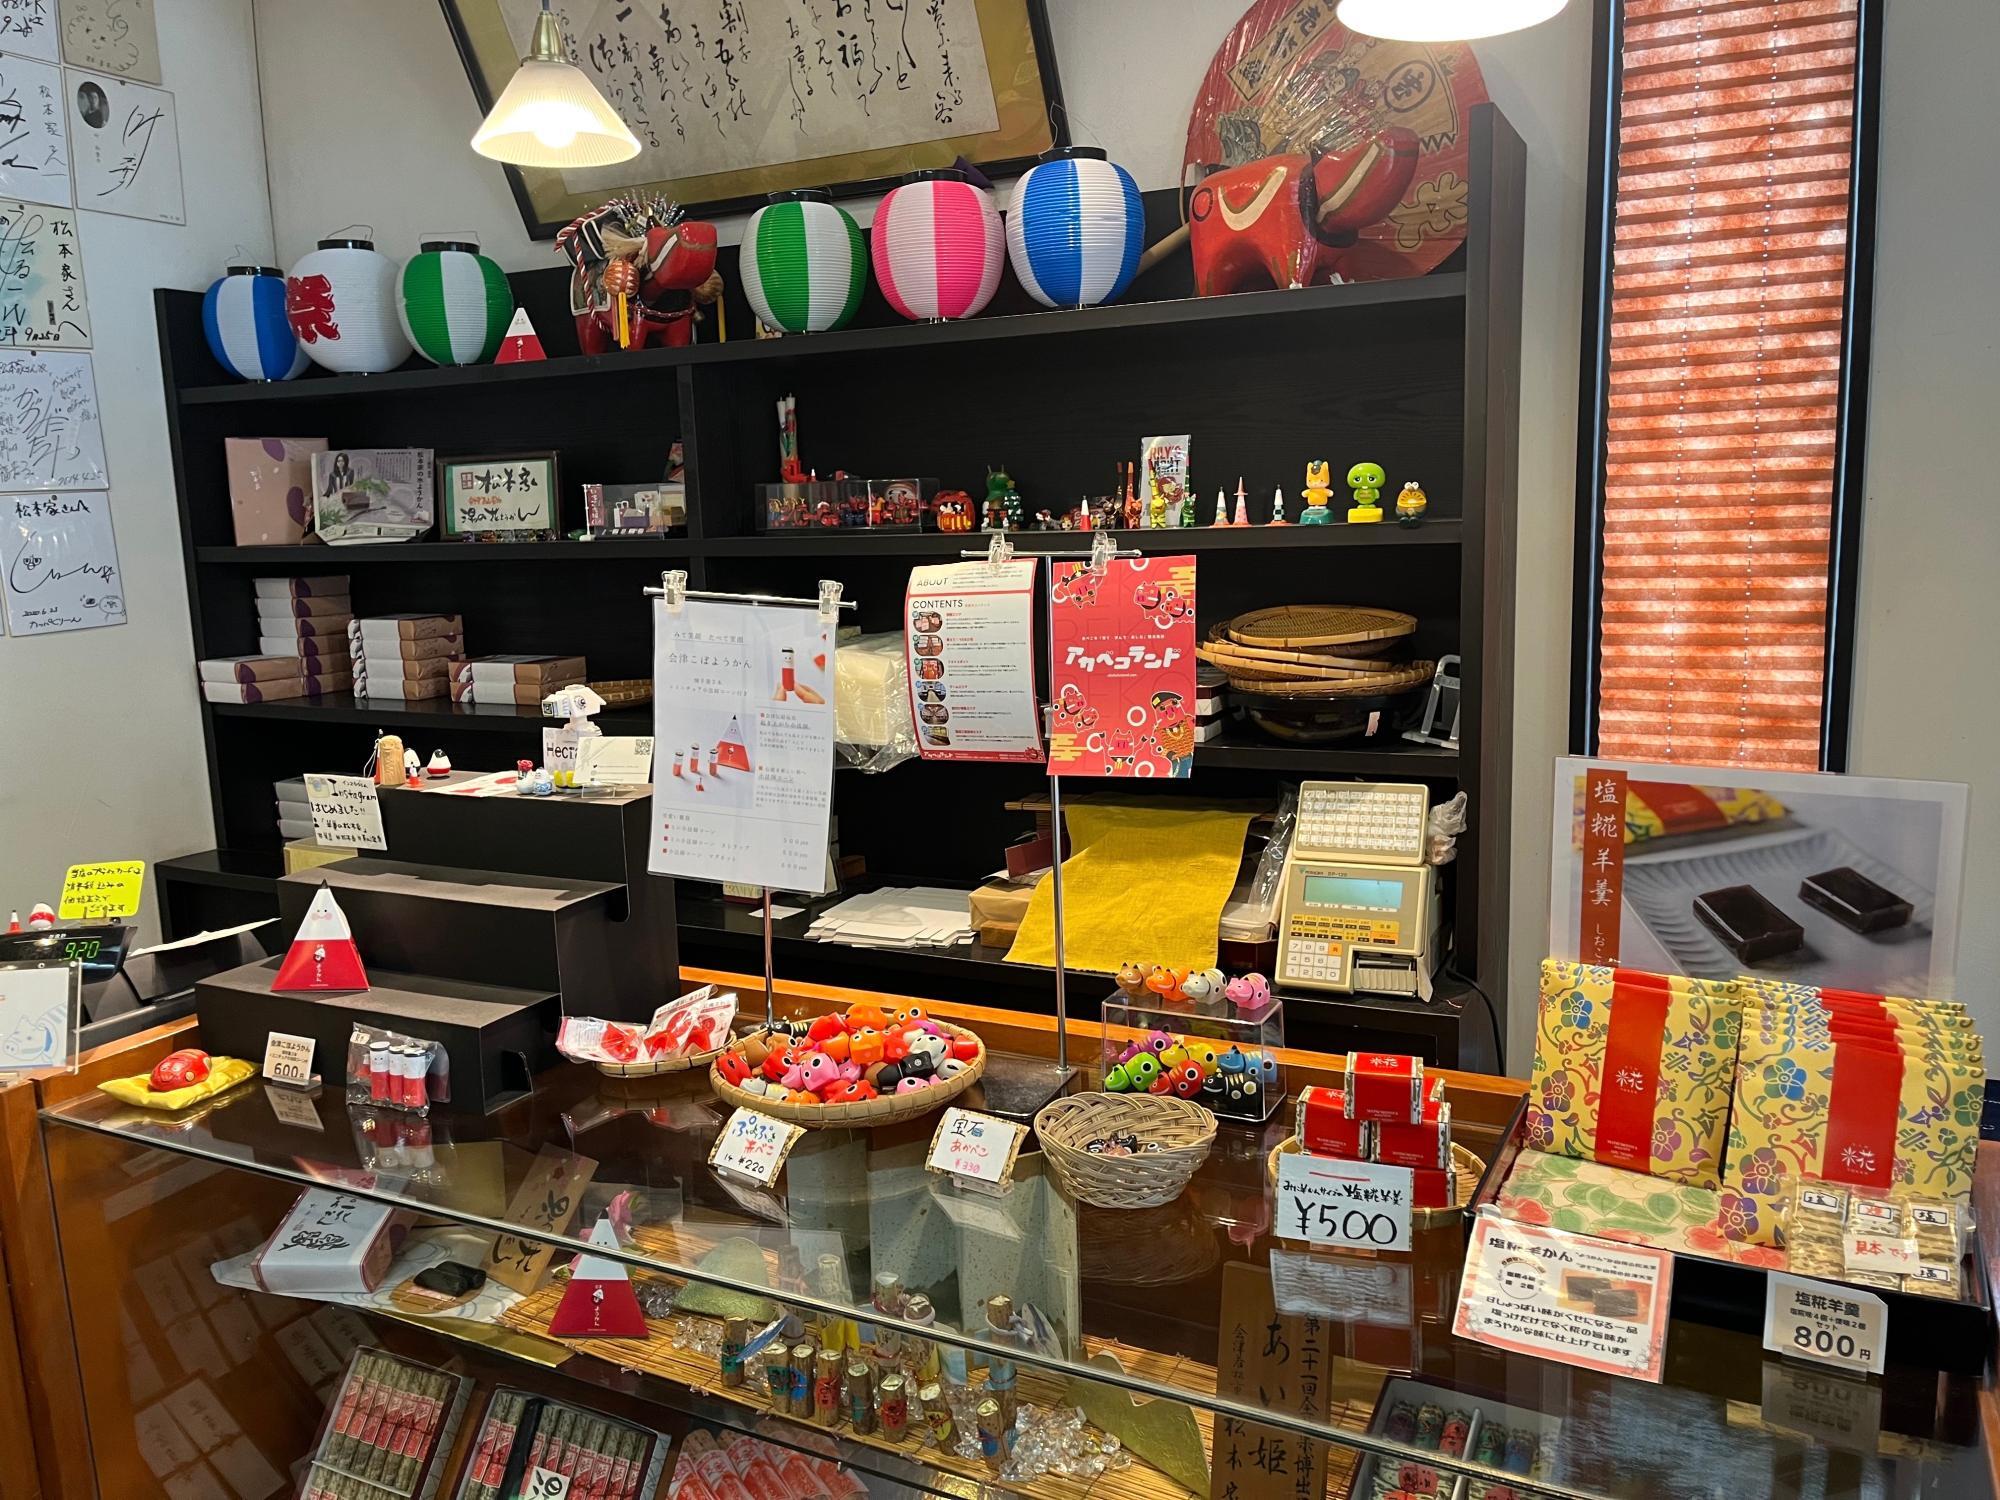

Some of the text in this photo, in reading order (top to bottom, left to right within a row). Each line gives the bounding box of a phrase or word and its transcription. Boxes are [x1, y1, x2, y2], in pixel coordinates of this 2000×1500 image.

[917, 578, 948, 586] ABOUT
[912, 599, 963, 608] CONTENTS
[63, 942, 100, 961] 920
[950, 1113, 984, 1138] 宝石
[1294, 1195, 1398, 1244] ¥500
[1855, 1240, 1884, 1256] 見本
[1794, 1325, 1871, 1360] 800 円
